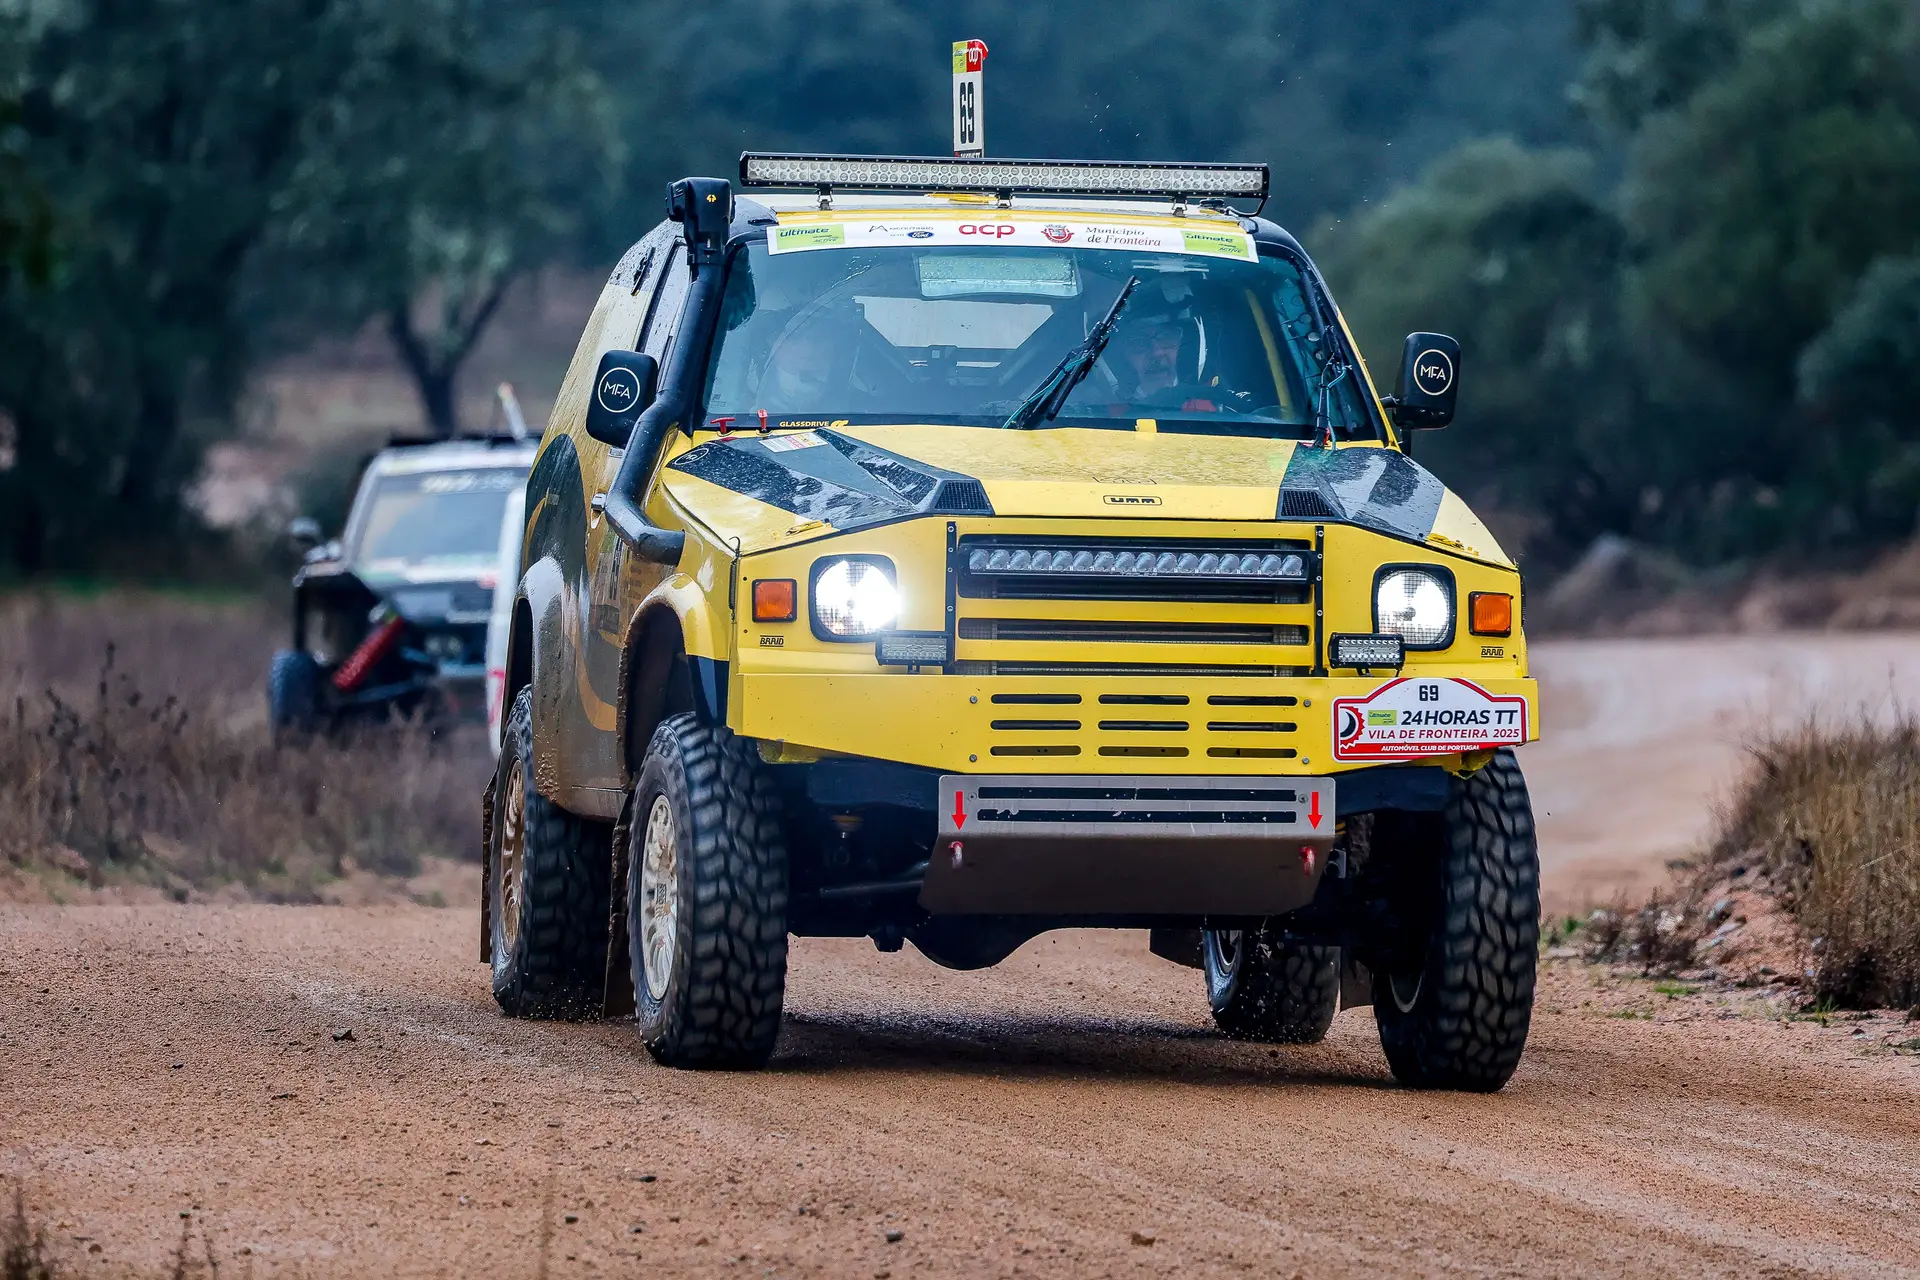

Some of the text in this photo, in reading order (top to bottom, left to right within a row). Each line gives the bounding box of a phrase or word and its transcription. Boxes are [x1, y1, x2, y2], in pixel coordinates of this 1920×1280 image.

[960, 82, 975, 144] 69
[780, 228, 829, 237] ultimate
[959, 224, 1015, 238] acp
[1087, 235, 1161, 247] de Fronteira
[1420, 364, 1446, 381] MFA
[604, 381, 630, 399] MFA
[780, 420, 829, 428] GLASSDRIVE
[760, 636, 784, 646] BRAID
[1481, 648, 1504, 656] BRAID
[1419, 685, 1439, 701] 69
[1495, 710, 1518, 725] TT
[1368, 728, 1520, 740] VILA DE FRONTEIRA 2025
